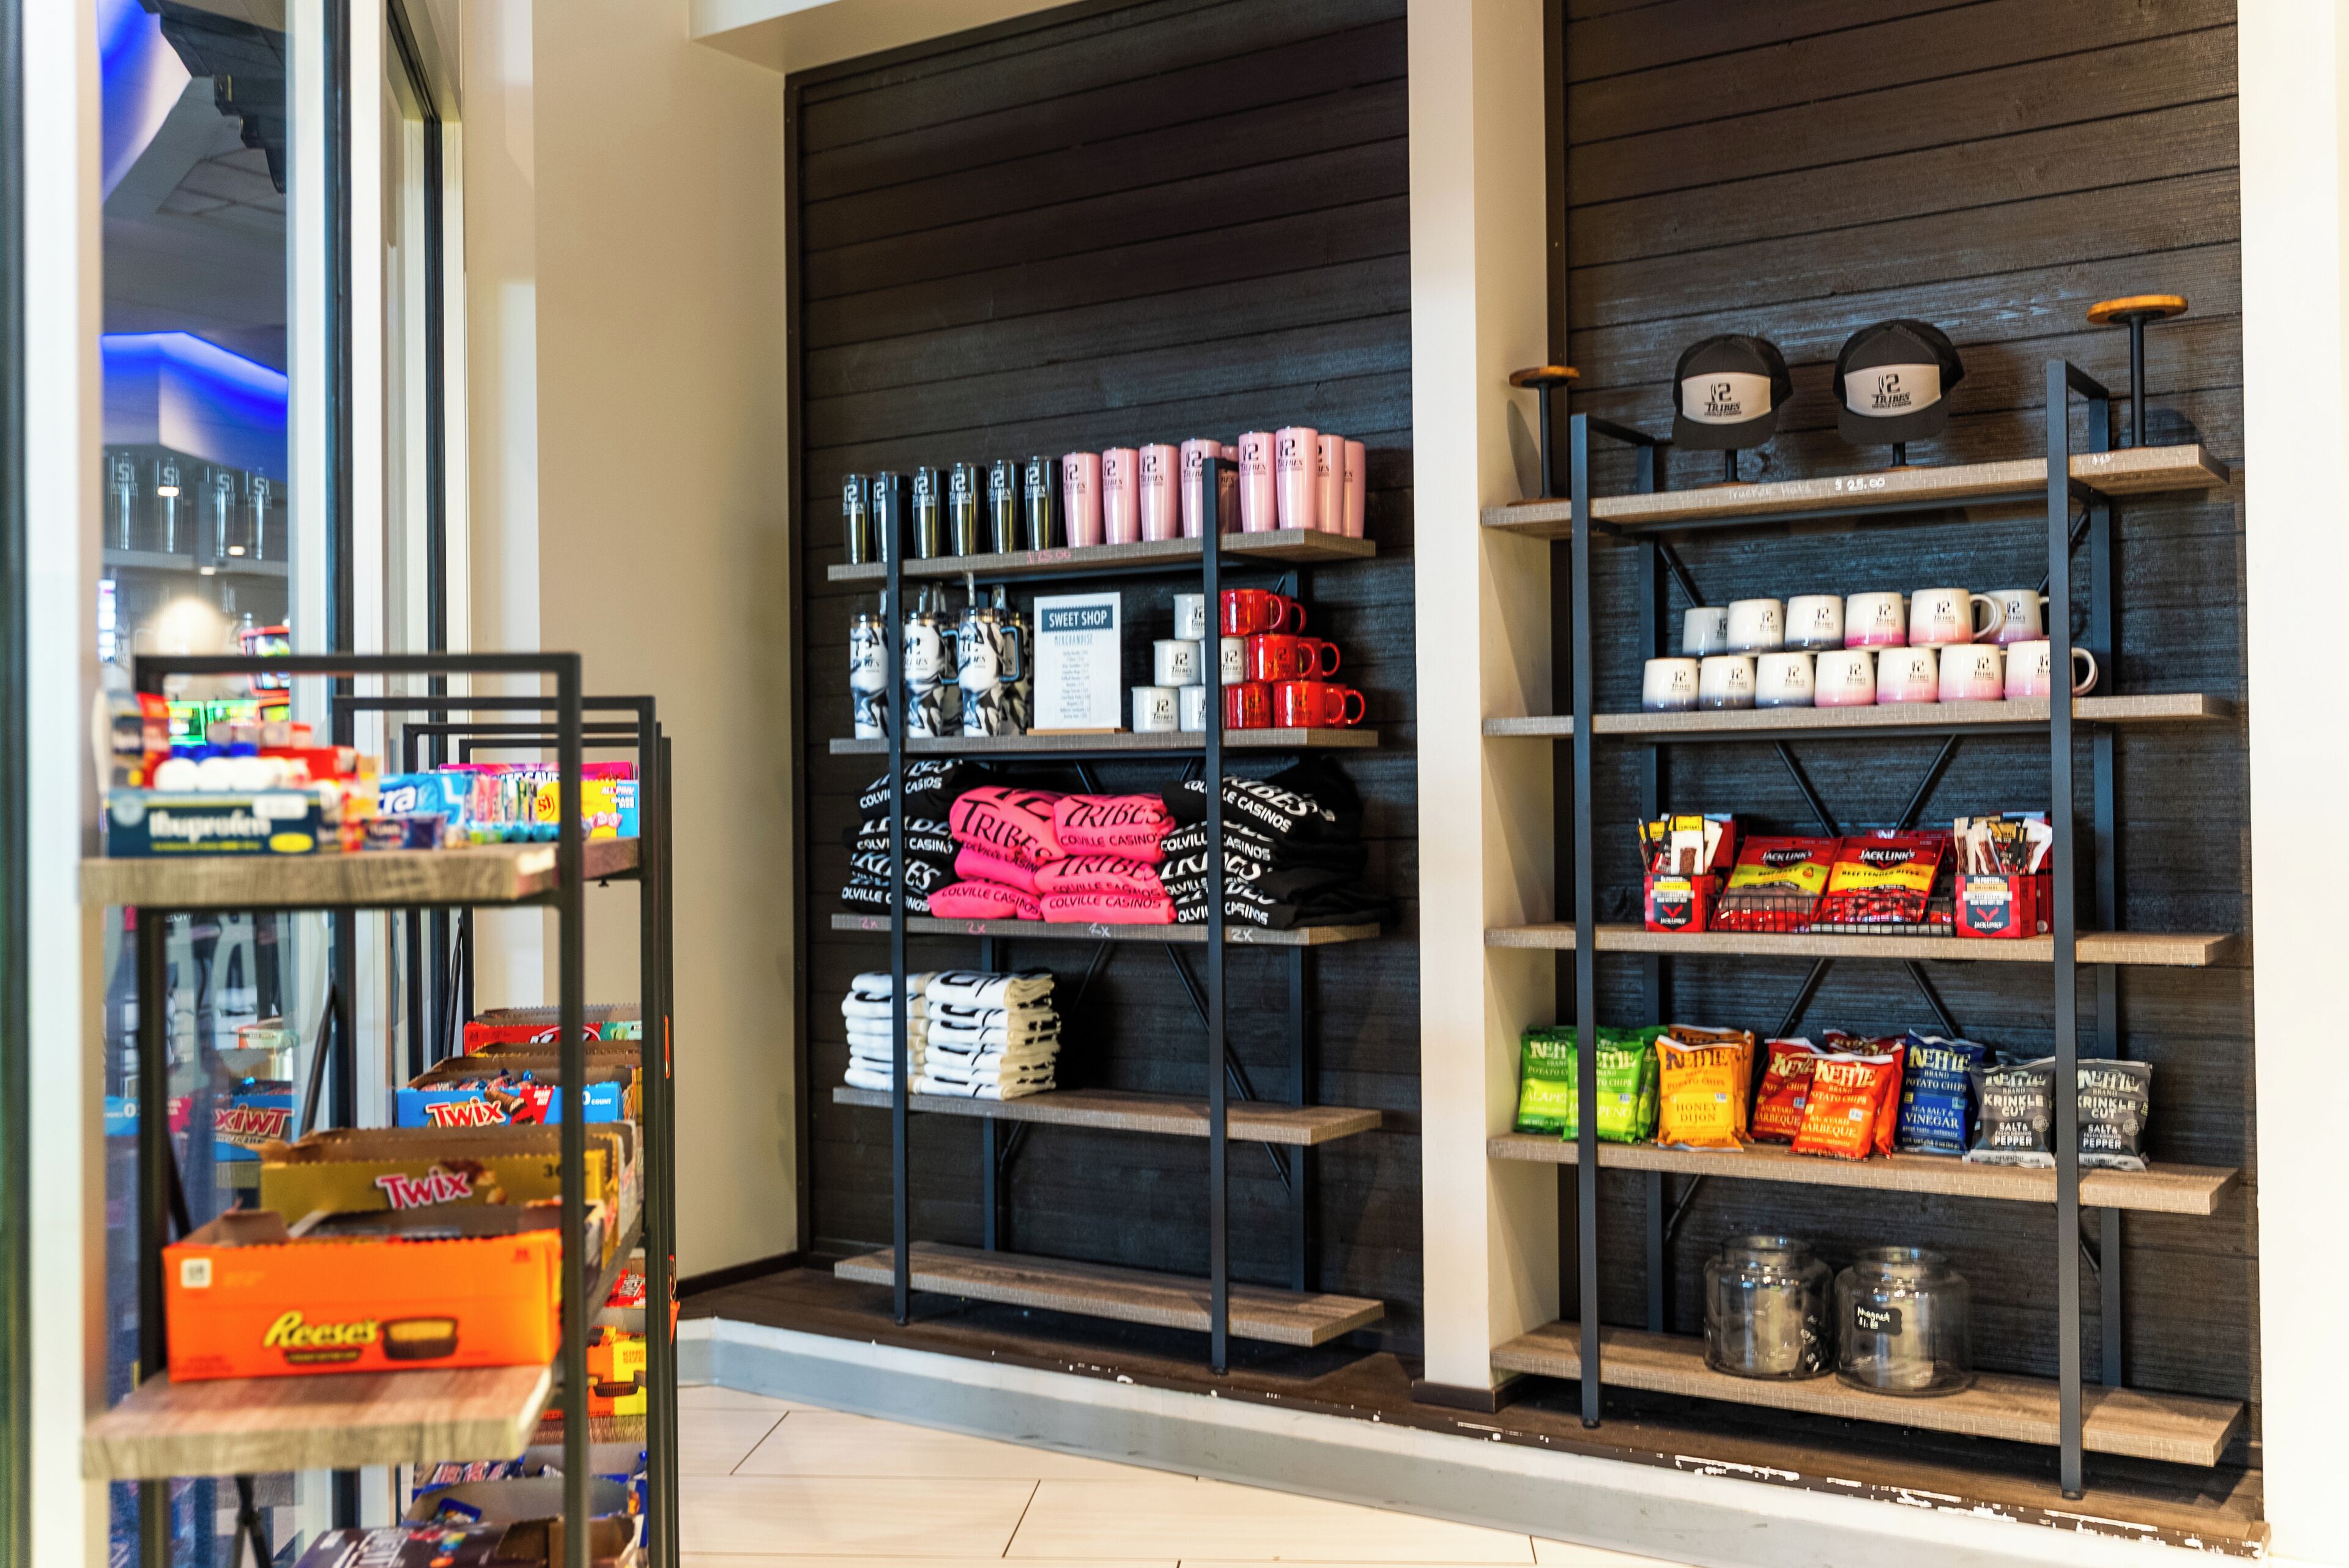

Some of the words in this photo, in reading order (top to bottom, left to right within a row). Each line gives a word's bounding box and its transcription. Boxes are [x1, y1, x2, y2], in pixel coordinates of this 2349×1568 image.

[1879, 373, 1900, 394] 12
[1711, 383, 1731, 402] 12
[1241, 462, 1266, 472] TRIBES
[1278, 459, 1302, 468] TRIBES
[1049, 612, 1079, 628] SWEET
[1082, 610, 1107, 626] SHOP
[1176, 652, 1187, 666] 12
[1225, 649, 1237, 664] 12
[1157, 699, 1168, 713] 12
[905, 777, 942, 794] CASIOS
[377, 786, 416, 812] tra
[1064, 796, 1164, 827] TRIBES
[1238, 796, 1292, 832] CASINOS
[149, 811, 272, 843] Ibuprofen
[910, 837, 952, 854] CASINO
[1109, 832, 1158, 846] CASINO
[1161, 832, 1208, 851] COLVILL
[1224, 834, 1270, 862] ASINOS
[1858, 849, 1884, 861] JACK
[1885, 848, 1915, 861] LINK'S
[1004, 852, 1041, 873] CASIN
[1761, 851, 1783, 862] JACK
[842, 887, 883, 903] OLVILLE
[942, 887, 991, 900] COLVILLE
[993, 890, 1039, 914] CASINOS
[1050, 896, 1101, 909] COLVILLE
[1106, 896, 1161, 909] CASINOS
[1909, 1045, 1971, 1073] KETTLE
[1814, 1059, 1876, 1087] KETTLE
[1924, 1070, 1950, 1079] BRAND
[1828, 1085, 1853, 1094] BRAND
[1906, 1078, 1939, 1089] POTATO
[1941, 1081, 1967, 1093] CHIPS
[1984, 1093, 2044, 1108] KRINKLE
[1680, 1113, 1716, 1123] DIJON
[1927, 1106, 1946, 1116] SALT
[2002, 1106, 2026, 1117] CUT
[2091, 1108, 2115, 1119] CUT
[1906, 1112, 1960, 1130] VINEGAR
[1999, 1122, 2022, 1131] SALT
[2088, 1124, 2111, 1134] SALT
[1994, 1136, 2032, 1147] PEPPER
[2083, 1137, 2121, 1150] PEPPER
